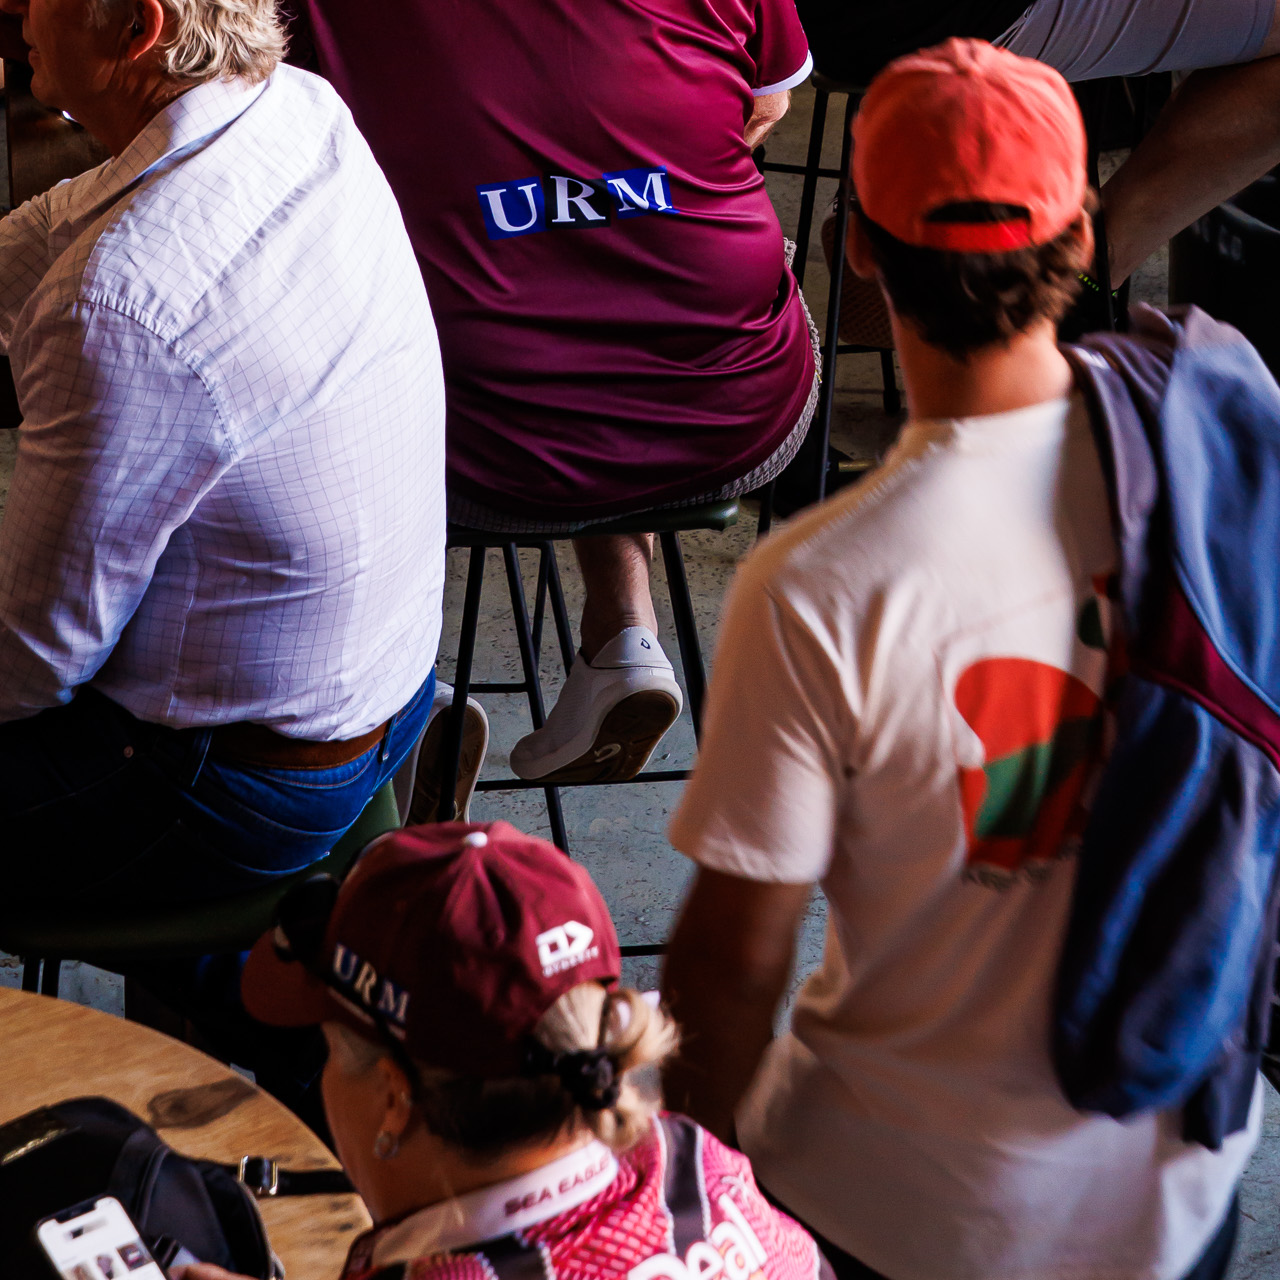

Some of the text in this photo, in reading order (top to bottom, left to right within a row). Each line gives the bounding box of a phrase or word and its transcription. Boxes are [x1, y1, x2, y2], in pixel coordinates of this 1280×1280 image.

[480, 173, 674, 235] URM
[332, 944, 410, 1025] URM
[504, 1155, 611, 1218] SEA EAGLE
